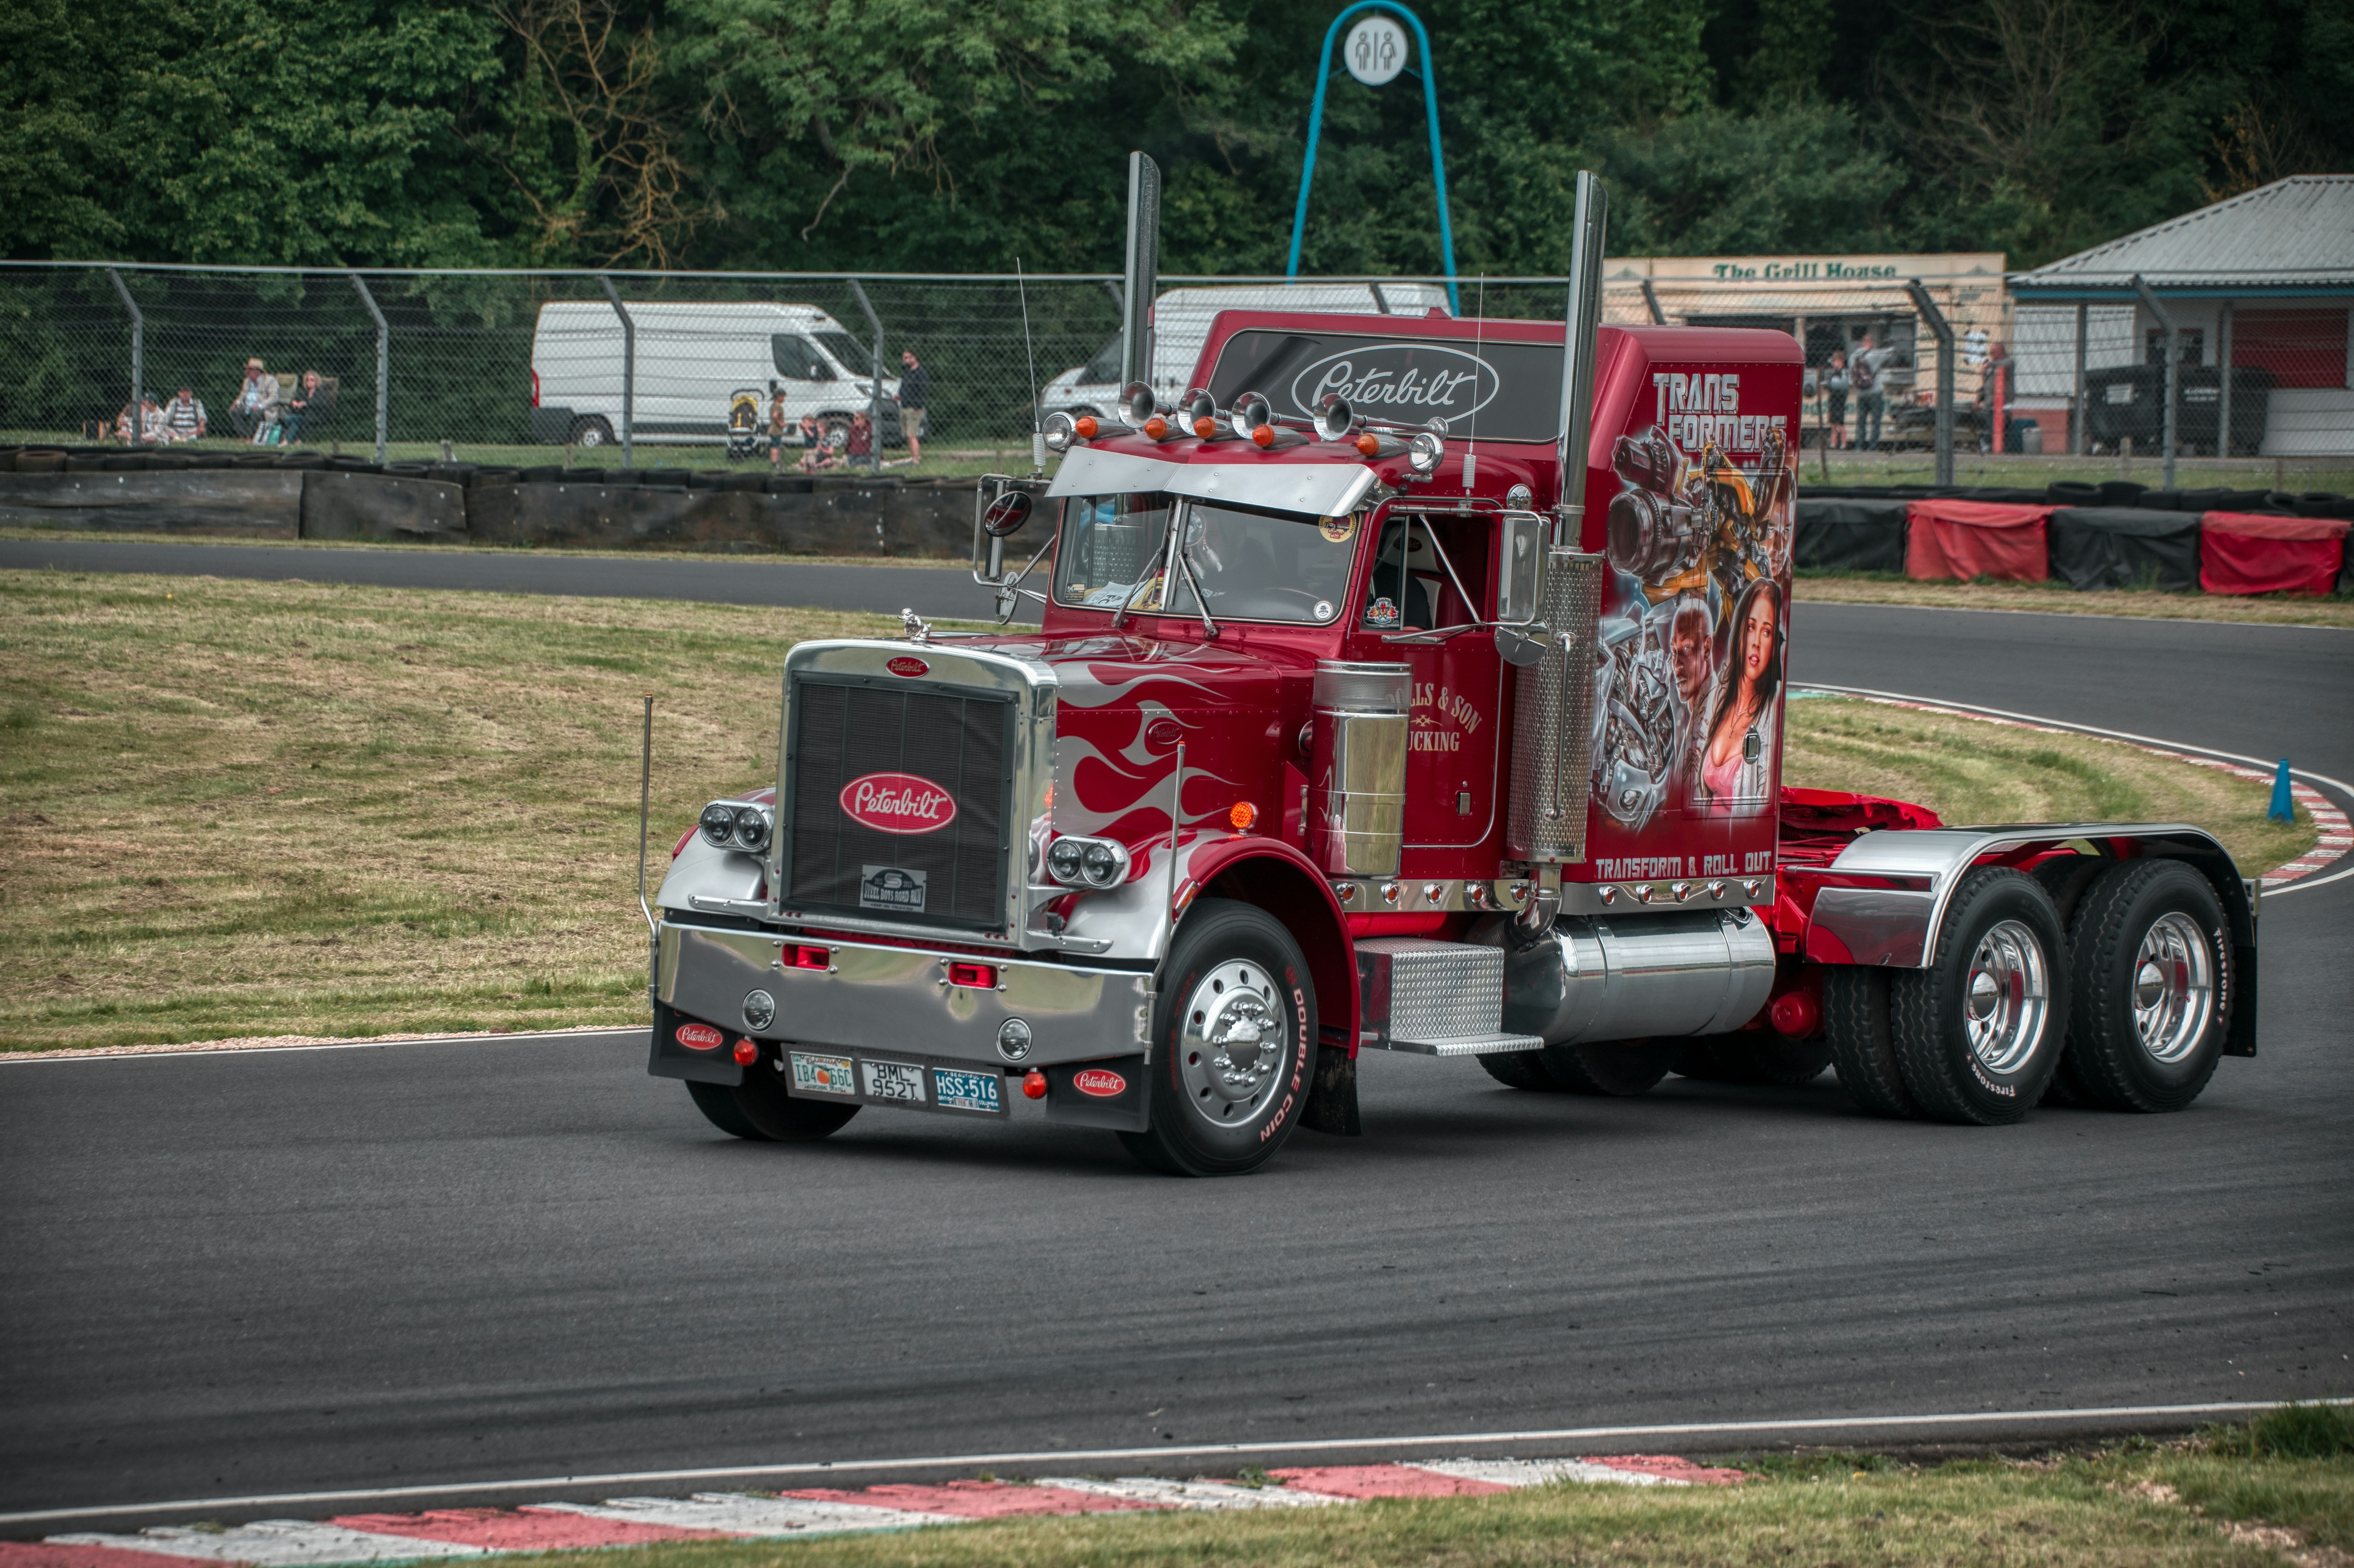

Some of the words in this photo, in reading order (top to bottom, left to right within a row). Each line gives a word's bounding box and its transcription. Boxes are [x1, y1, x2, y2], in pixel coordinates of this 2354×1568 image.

[1712, 262, 1757, 280] The
[1764, 261, 1819, 280] Grill
[1825, 262, 1897, 279] House
[1312, 361, 1477, 407] Peterbilt
[1653, 373, 1740, 426] TRANS
[891, 659, 924, 673] Peterbilt
[1437, 687, 1448, 711] &
[1450, 695, 1483, 735] SON
[1154, 726, 1179, 739] Peterbilt
[855, 781, 947, 819] Peterbilt
[1595, 857, 1681, 879] TRANSFORM
[1688, 856, 1697, 876] &
[1703, 853, 1738, 876] ROLL
[864, 881, 880, 900] STEEL
[880, 887, 894, 901] BOYS
[894, 890, 909, 903] ROAD
[910, 887, 923, 904] RUN
[2213, 927, 2228, 1011] Firestone
[682, 1027, 719, 1044] Peterbilt
[1291, 987, 1307, 1092] DOUBLE
[877, 1065, 910, 1082] BML
[1080, 1073, 1121, 1089] Peterbilt
[1971, 1062, 2016, 1097] Firestone
[872, 1078, 917, 1098] 952T
[1260, 1092, 1294, 1143] COIN
